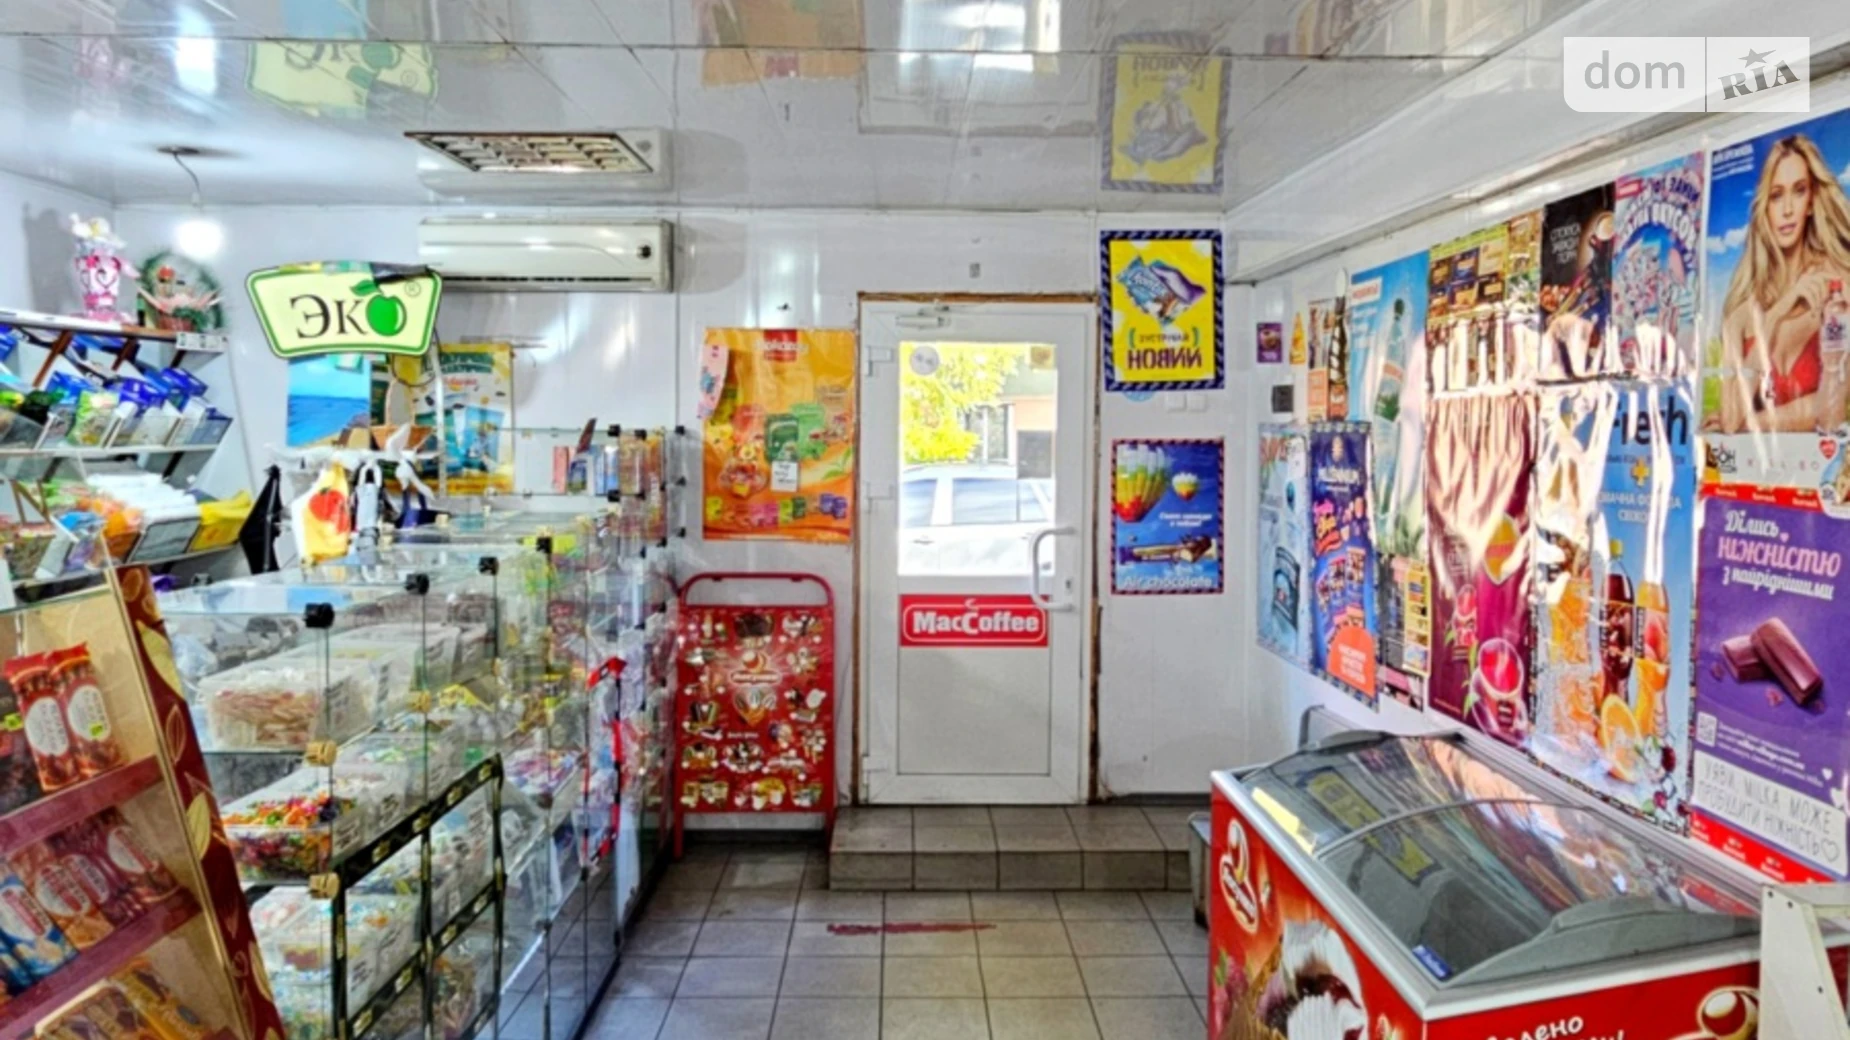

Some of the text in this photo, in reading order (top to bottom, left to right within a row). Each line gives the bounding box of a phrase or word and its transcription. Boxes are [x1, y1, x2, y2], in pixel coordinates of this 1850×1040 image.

[1725, 510, 1780, 538] Ділись
[913, 611, 1040, 635] MacCoffee
[1789, 796, 1832, 835] МОЖЕ
